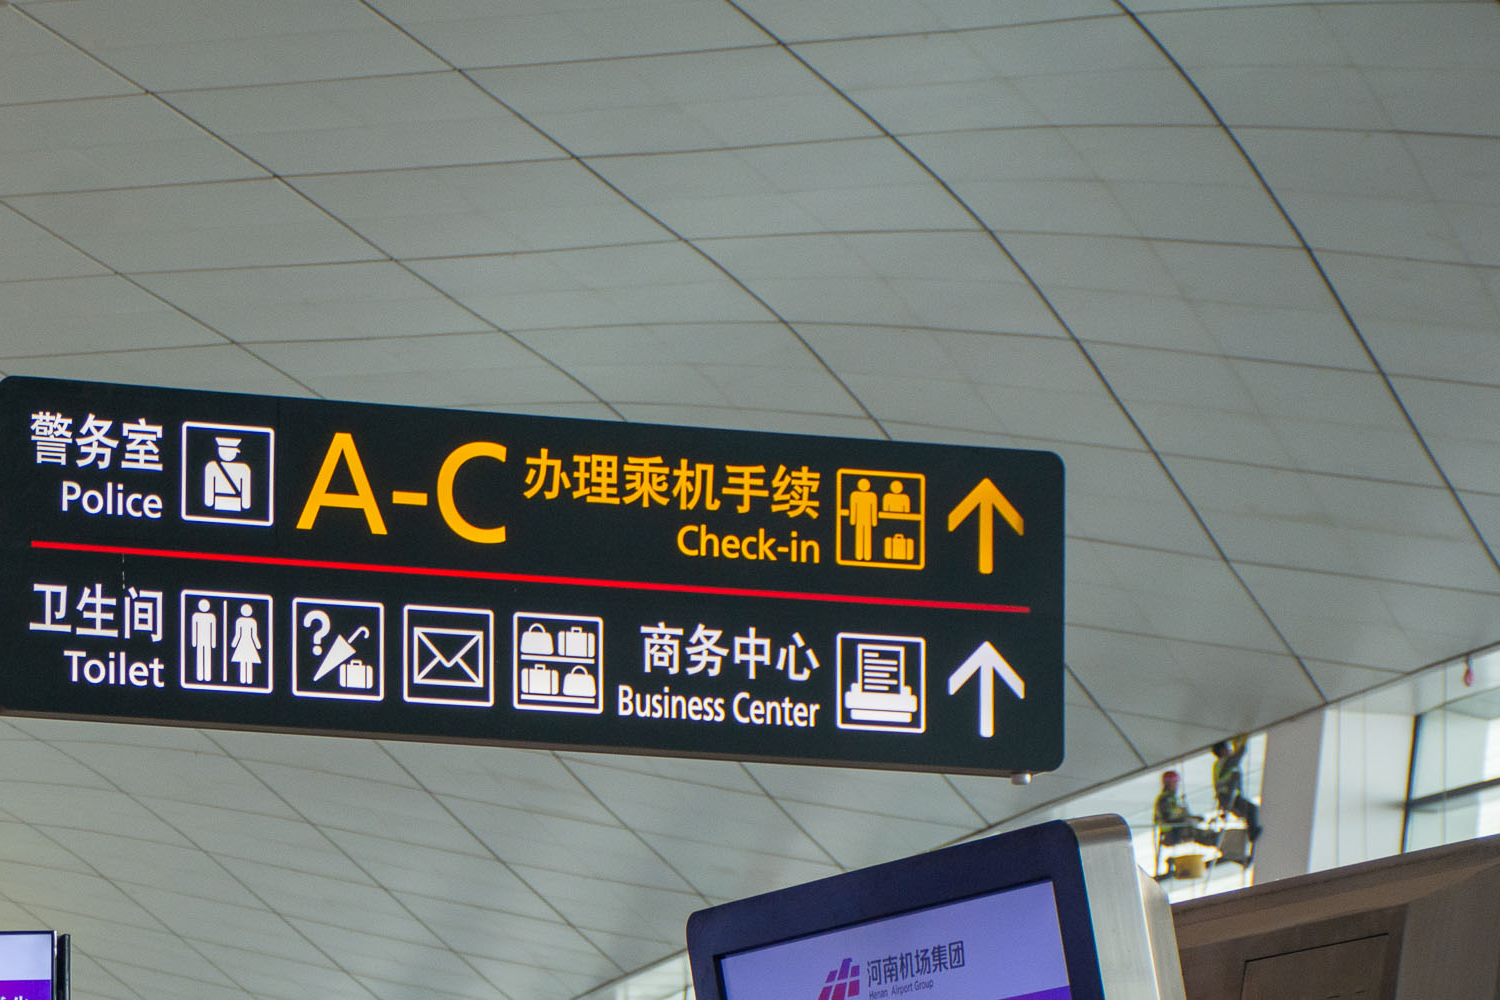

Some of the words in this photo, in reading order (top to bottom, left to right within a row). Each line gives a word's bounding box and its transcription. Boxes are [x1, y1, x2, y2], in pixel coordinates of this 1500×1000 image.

[30, 411, 163, 471] 警务室
[62, 480, 163, 518] Police
[296, 432, 507, 544] A-C
[523, 448, 820, 519] 办理乘机手续
[677, 524, 820, 563] Check-in
[29, 583, 163, 642] 卫生间
[64, 650, 164, 687] Toilet
[640, 622, 820, 681] 商务中心
[618, 685, 725, 722] Business
[733, 692, 820, 727] Center
[867, 940, 965, 987] 河南机场集团
[868, 989, 888, 1000] Henan
[891, 984, 913, 997] Airport
[914, 979, 934, 992] Group
